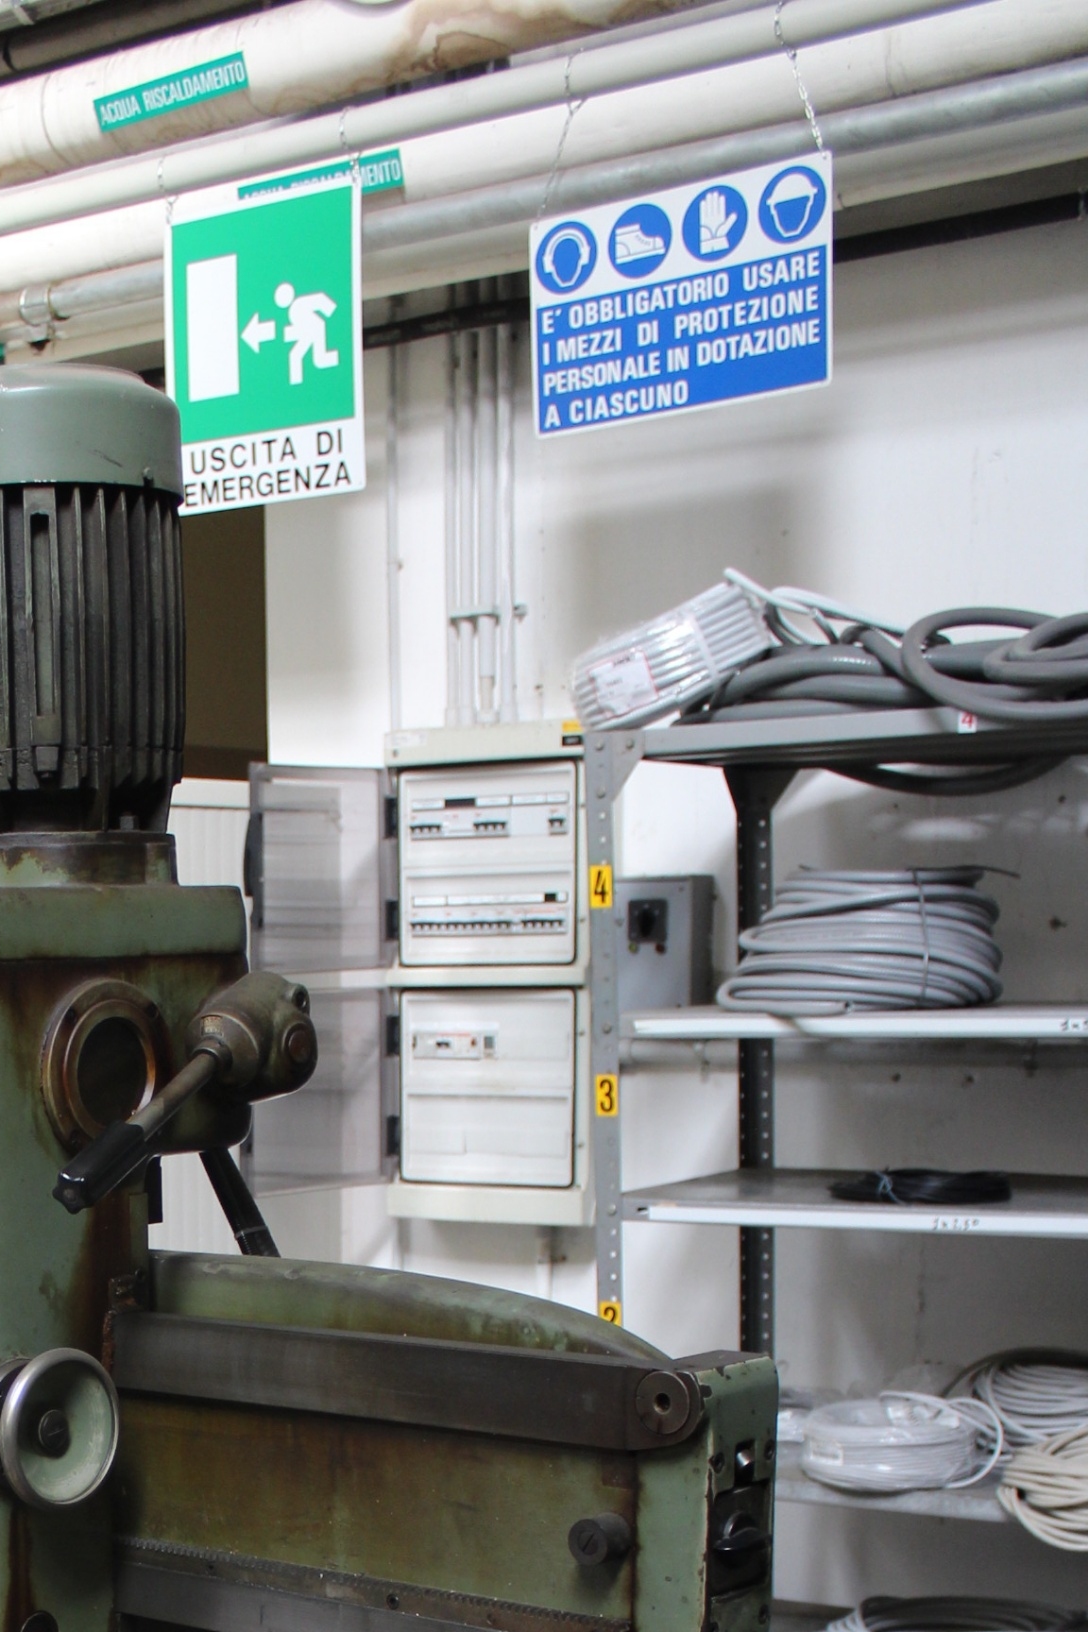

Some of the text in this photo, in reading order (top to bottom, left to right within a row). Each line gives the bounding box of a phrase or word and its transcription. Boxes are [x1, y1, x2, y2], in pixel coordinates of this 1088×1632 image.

[99, 61, 245, 126] ACQUA RISCALDAMENTO
[568, 272, 730, 329] OBBLIGATORIO
[743, 252, 820, 291] USARE
[543, 286, 819, 365] I MEZZI DI PROTEZIONE
[543, 319, 820, 396] PERSONALE IN DOTAZIONE
[544, 380, 689, 429] A CIASCUNO
[190, 428, 343, 475] USCITA DI
[183, 461, 352, 507] EMERGENZA
[594, 870, 609, 904] 4
[599, 1079, 613, 1113] 3
